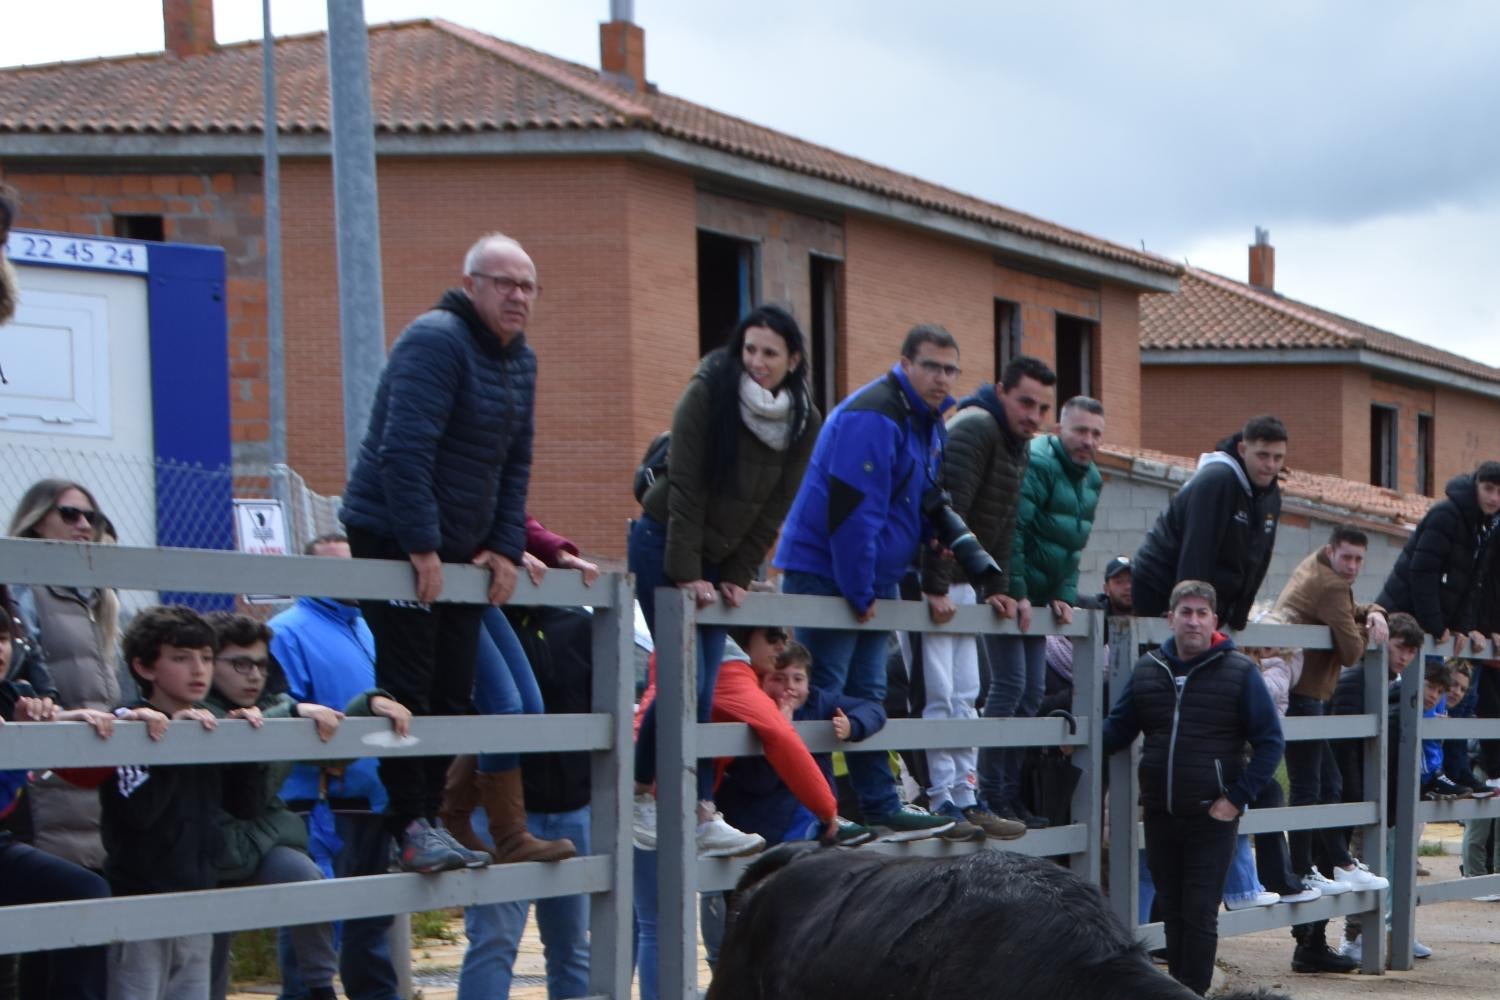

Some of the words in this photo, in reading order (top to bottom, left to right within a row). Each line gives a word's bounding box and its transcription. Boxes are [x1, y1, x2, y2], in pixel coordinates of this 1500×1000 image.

[23, 236, 53, 258] 22
[64, 241, 94, 262] 45
[104, 244, 135, 267] 24
